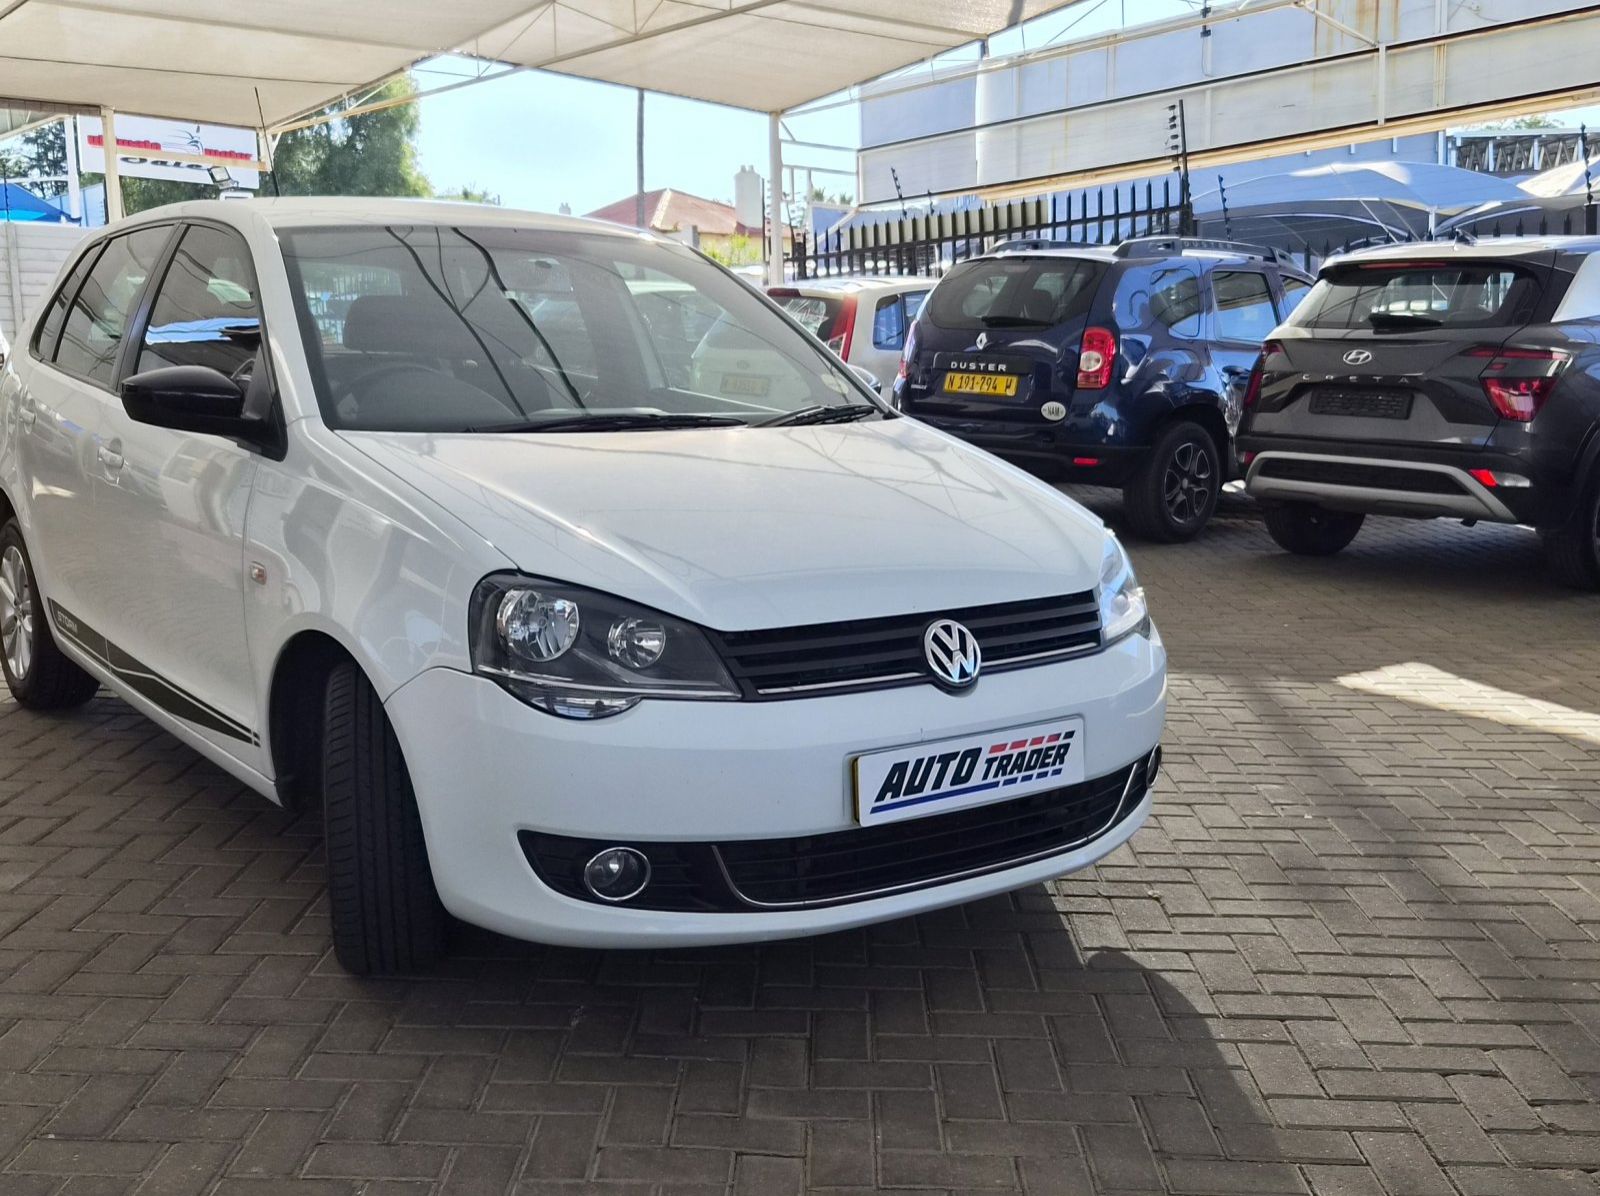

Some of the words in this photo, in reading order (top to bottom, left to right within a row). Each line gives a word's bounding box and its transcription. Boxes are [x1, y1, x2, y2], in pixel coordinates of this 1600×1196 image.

[951, 361, 1007, 372] DUSTER
[948, 375, 956, 389] N
[1302, 373, 1409, 383] CRETA
[57, 610, 78, 633] STORM
[874, 747, 983, 803] AUTO
[982, 742, 1072, 781] TRADER
